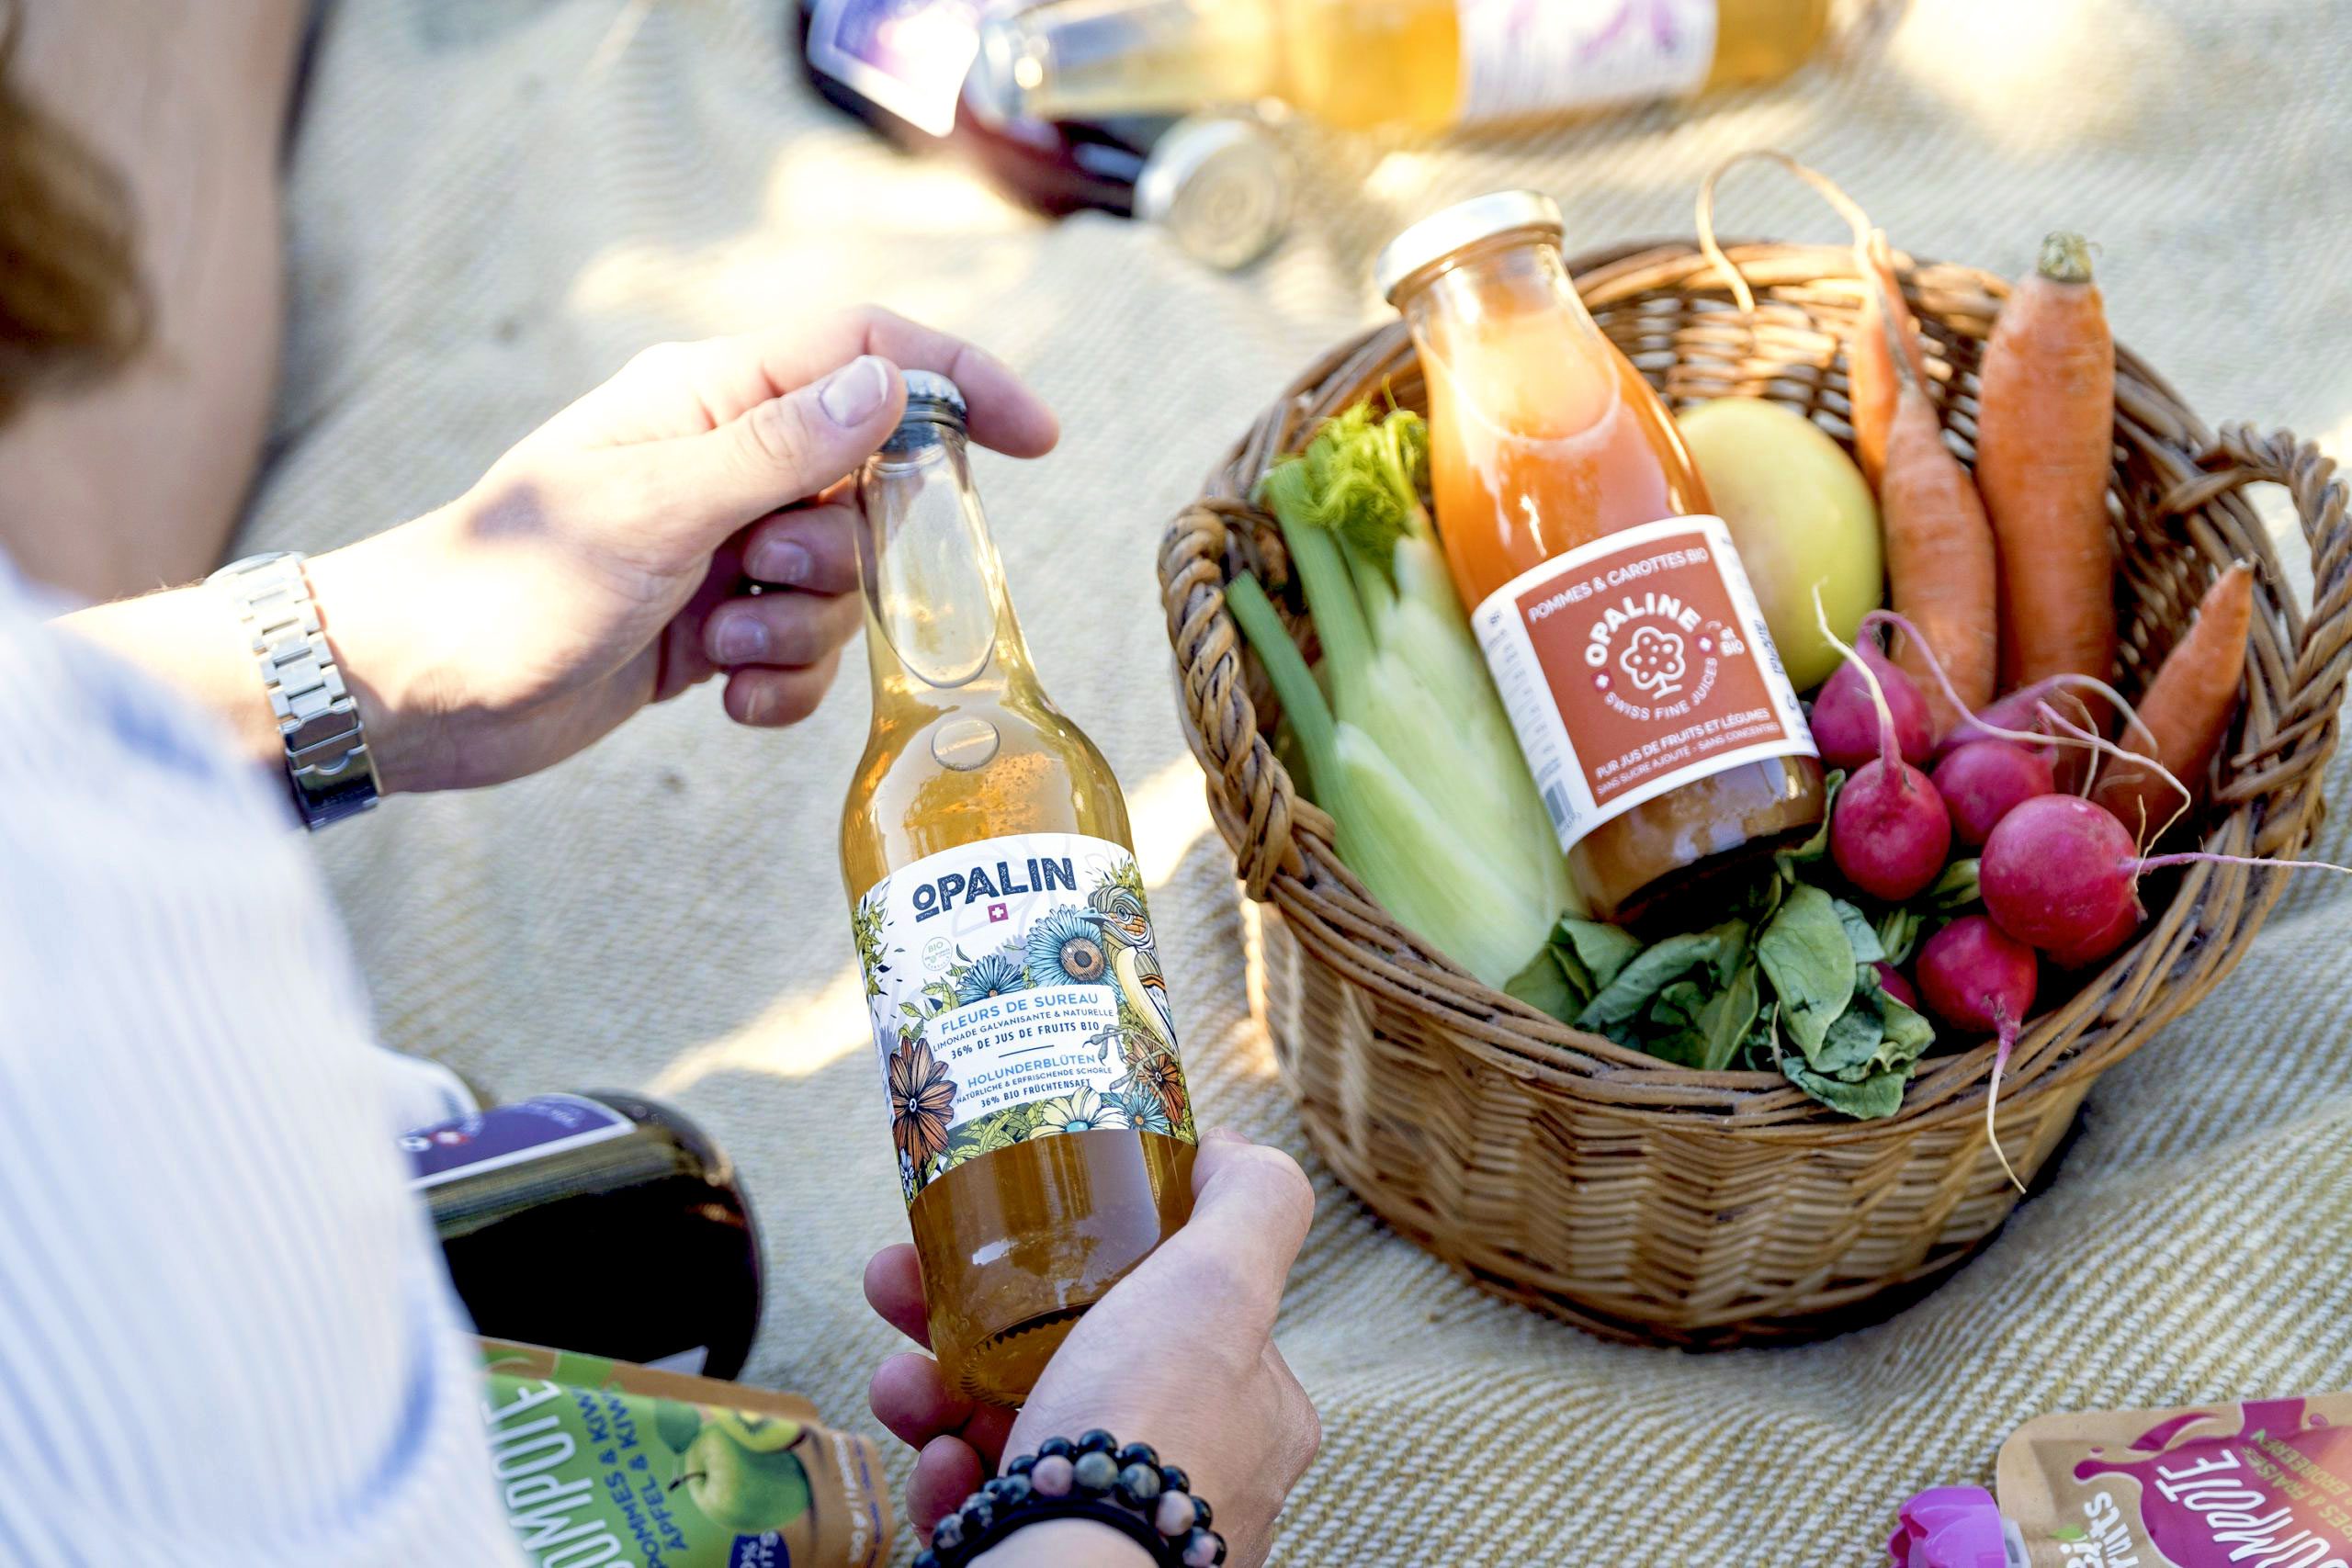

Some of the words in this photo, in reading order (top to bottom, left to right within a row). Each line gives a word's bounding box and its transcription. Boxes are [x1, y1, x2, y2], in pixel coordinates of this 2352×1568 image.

[1528, 581, 1593, 625] POMMES
[1591, 576, 1608, 592] &
[1607, 550, 1687, 586] CAROTTES
[1685, 547, 1709, 564] BIO
[1585, 592, 1702, 667] OPALINE
[1719, 639, 1746, 657] BIO
[1604, 692, 1651, 721] SWISS
[1654, 699, 1690, 721] FINE
[1690, 657, 1718, 705] JUICES
[1595, 760, 1619, 779] PUR
[1620, 749, 1643, 768] JUS
[1641, 740, 1661, 757] DE
[1660, 725, 1705, 750] FRUITS
[1703, 718, 1721, 735] ET
[1720, 707, 1771, 729] LÉGUMES
[1597, 778, 1621, 796] SANS
[1619, 762, 1652, 786] SUCRE
[1698, 735, 1725, 752] SANS
[928, 942, 944, 953] BIO
[933, 1027, 978, 1053] LIMONADE
[979, 1011, 1052, 1032] GALVANISANTE
[1063, 1009, 1114, 1018] NATURELLE
[941, 1005, 1001, 1034] FLEURS
[1006, 998, 1029, 1013] DE
[1034, 993, 1099, 1008] SUREAU
[950, 1044, 973, 1059] 36%
[977, 1037, 990, 1050] DE
[995, 1031, 1015, 1044] JUS
[1019, 1027, 1034, 1038] DE
[1037, 1021, 1077, 1035] FRUITS
[1081, 1021, 1100, 1032] BIO
[967, 1054, 1095, 1088] HOLUNDERBLÜTEN
[1012, 1069, 1074, 1086] ERFRISCHENDE
[980, 1096, 1001, 1108] 36%
[1003, 1090, 1020, 1101] BIO
[1023, 1078, 1091, 1095] FRÜCHTENSAFT
